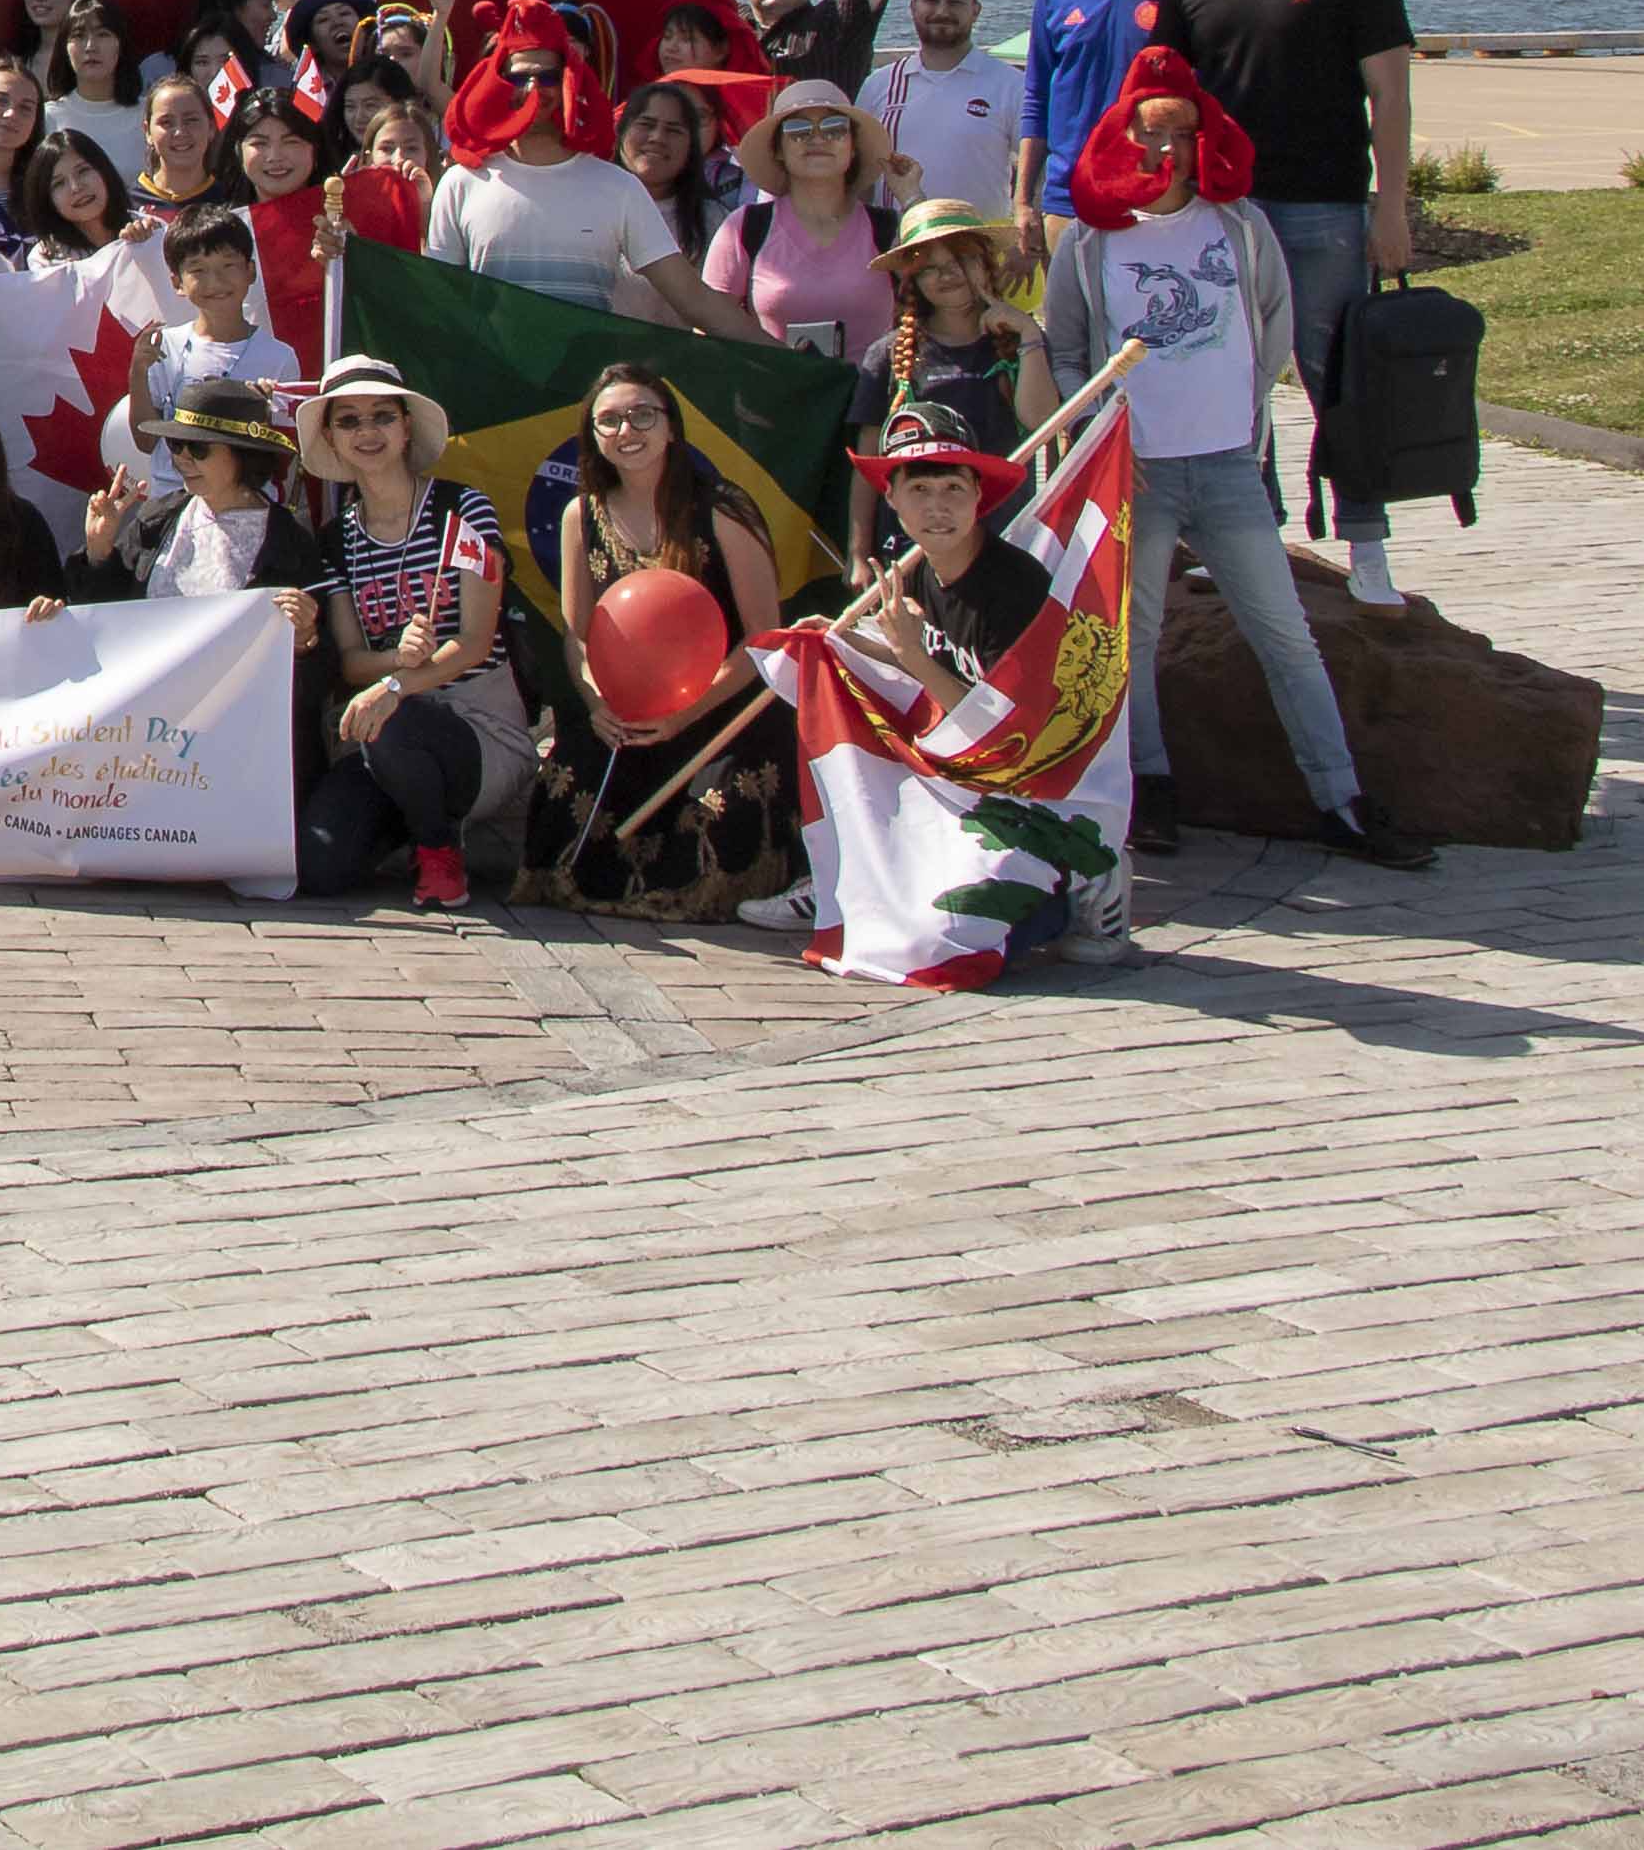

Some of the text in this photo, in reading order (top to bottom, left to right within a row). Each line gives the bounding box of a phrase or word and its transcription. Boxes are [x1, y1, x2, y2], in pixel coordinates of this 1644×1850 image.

[359, 571, 452, 635] GAP
[31, 714, 134, 743] Student
[145, 717, 197, 758] Day
[39, 756, 85, 782] des
[95, 752, 210, 791] étudiants
[52, 782, 129, 810] monde
[3, 814, 53, 838] CANADA
[65, 824, 141, 842] LANGUAGES
[144, 827, 198, 844] CANADA
